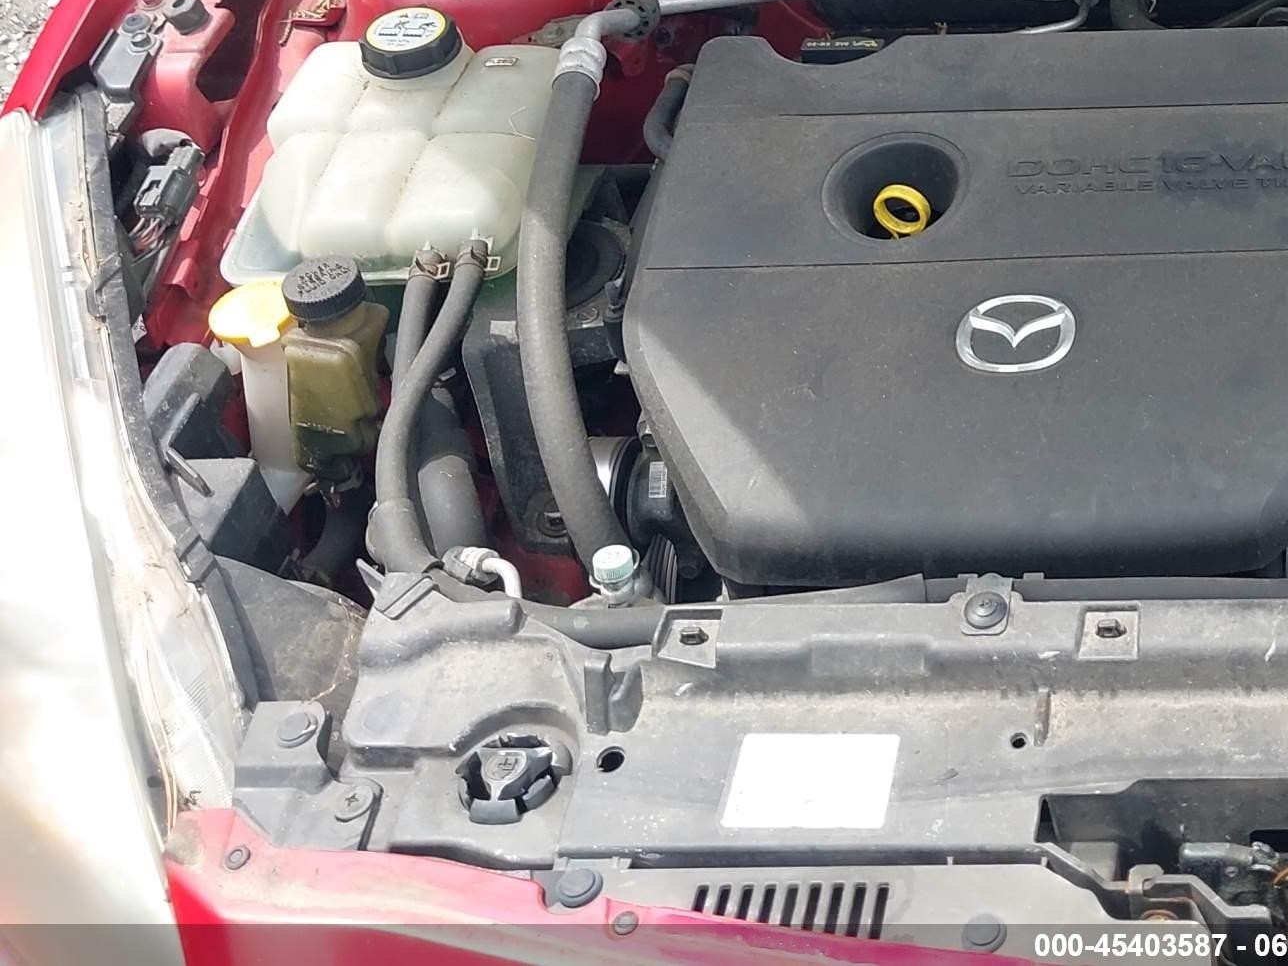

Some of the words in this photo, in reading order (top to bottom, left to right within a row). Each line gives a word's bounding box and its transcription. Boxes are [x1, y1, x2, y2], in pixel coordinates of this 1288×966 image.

[1007, 156, 1152, 178] DOHC
[1015, 180, 1154, 195] VARIABLE
[1161, 177, 1249, 191] VALVE
